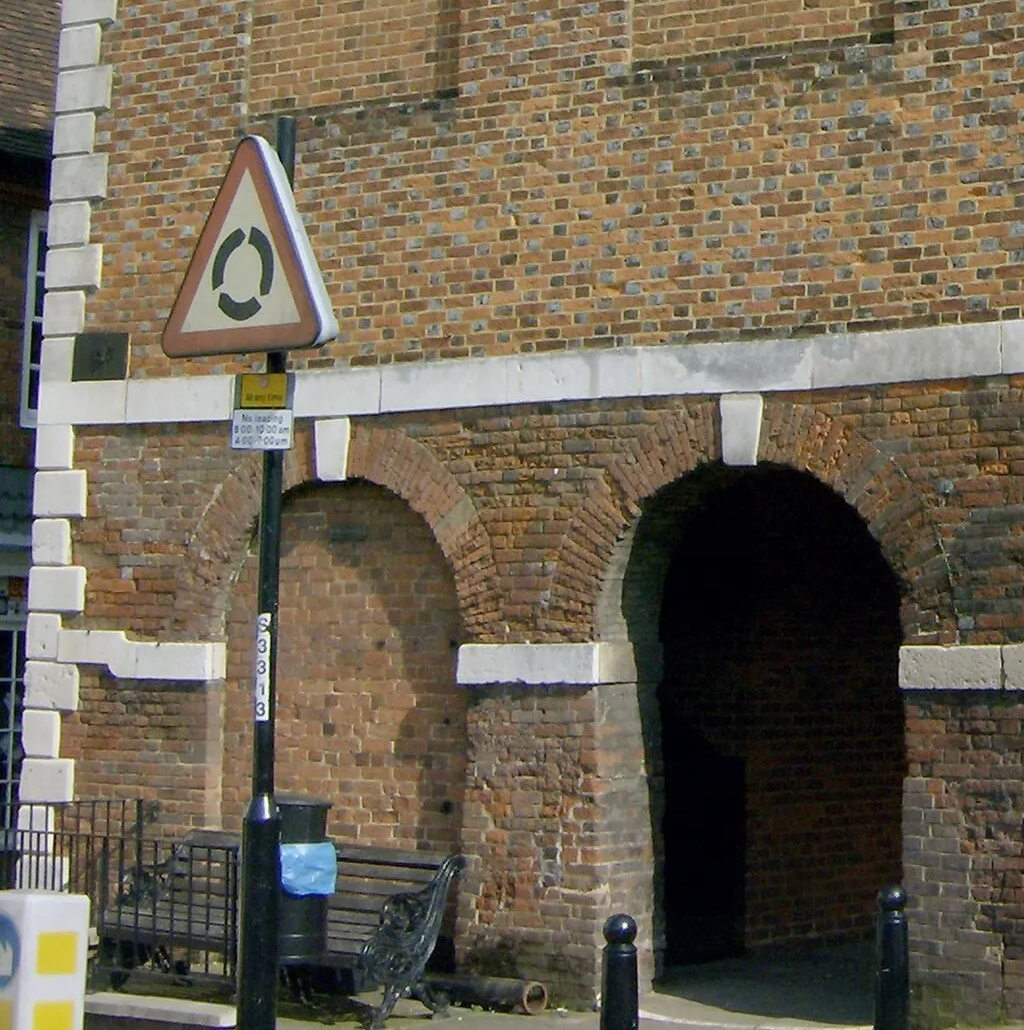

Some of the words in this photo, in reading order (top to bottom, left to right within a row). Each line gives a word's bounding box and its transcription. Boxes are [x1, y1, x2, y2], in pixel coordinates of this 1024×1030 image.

[254, 394, 266, 403] any
[267, 393, 283, 401] time
[242, 414, 252, 422] No
[254, 414, 284, 424] loading
